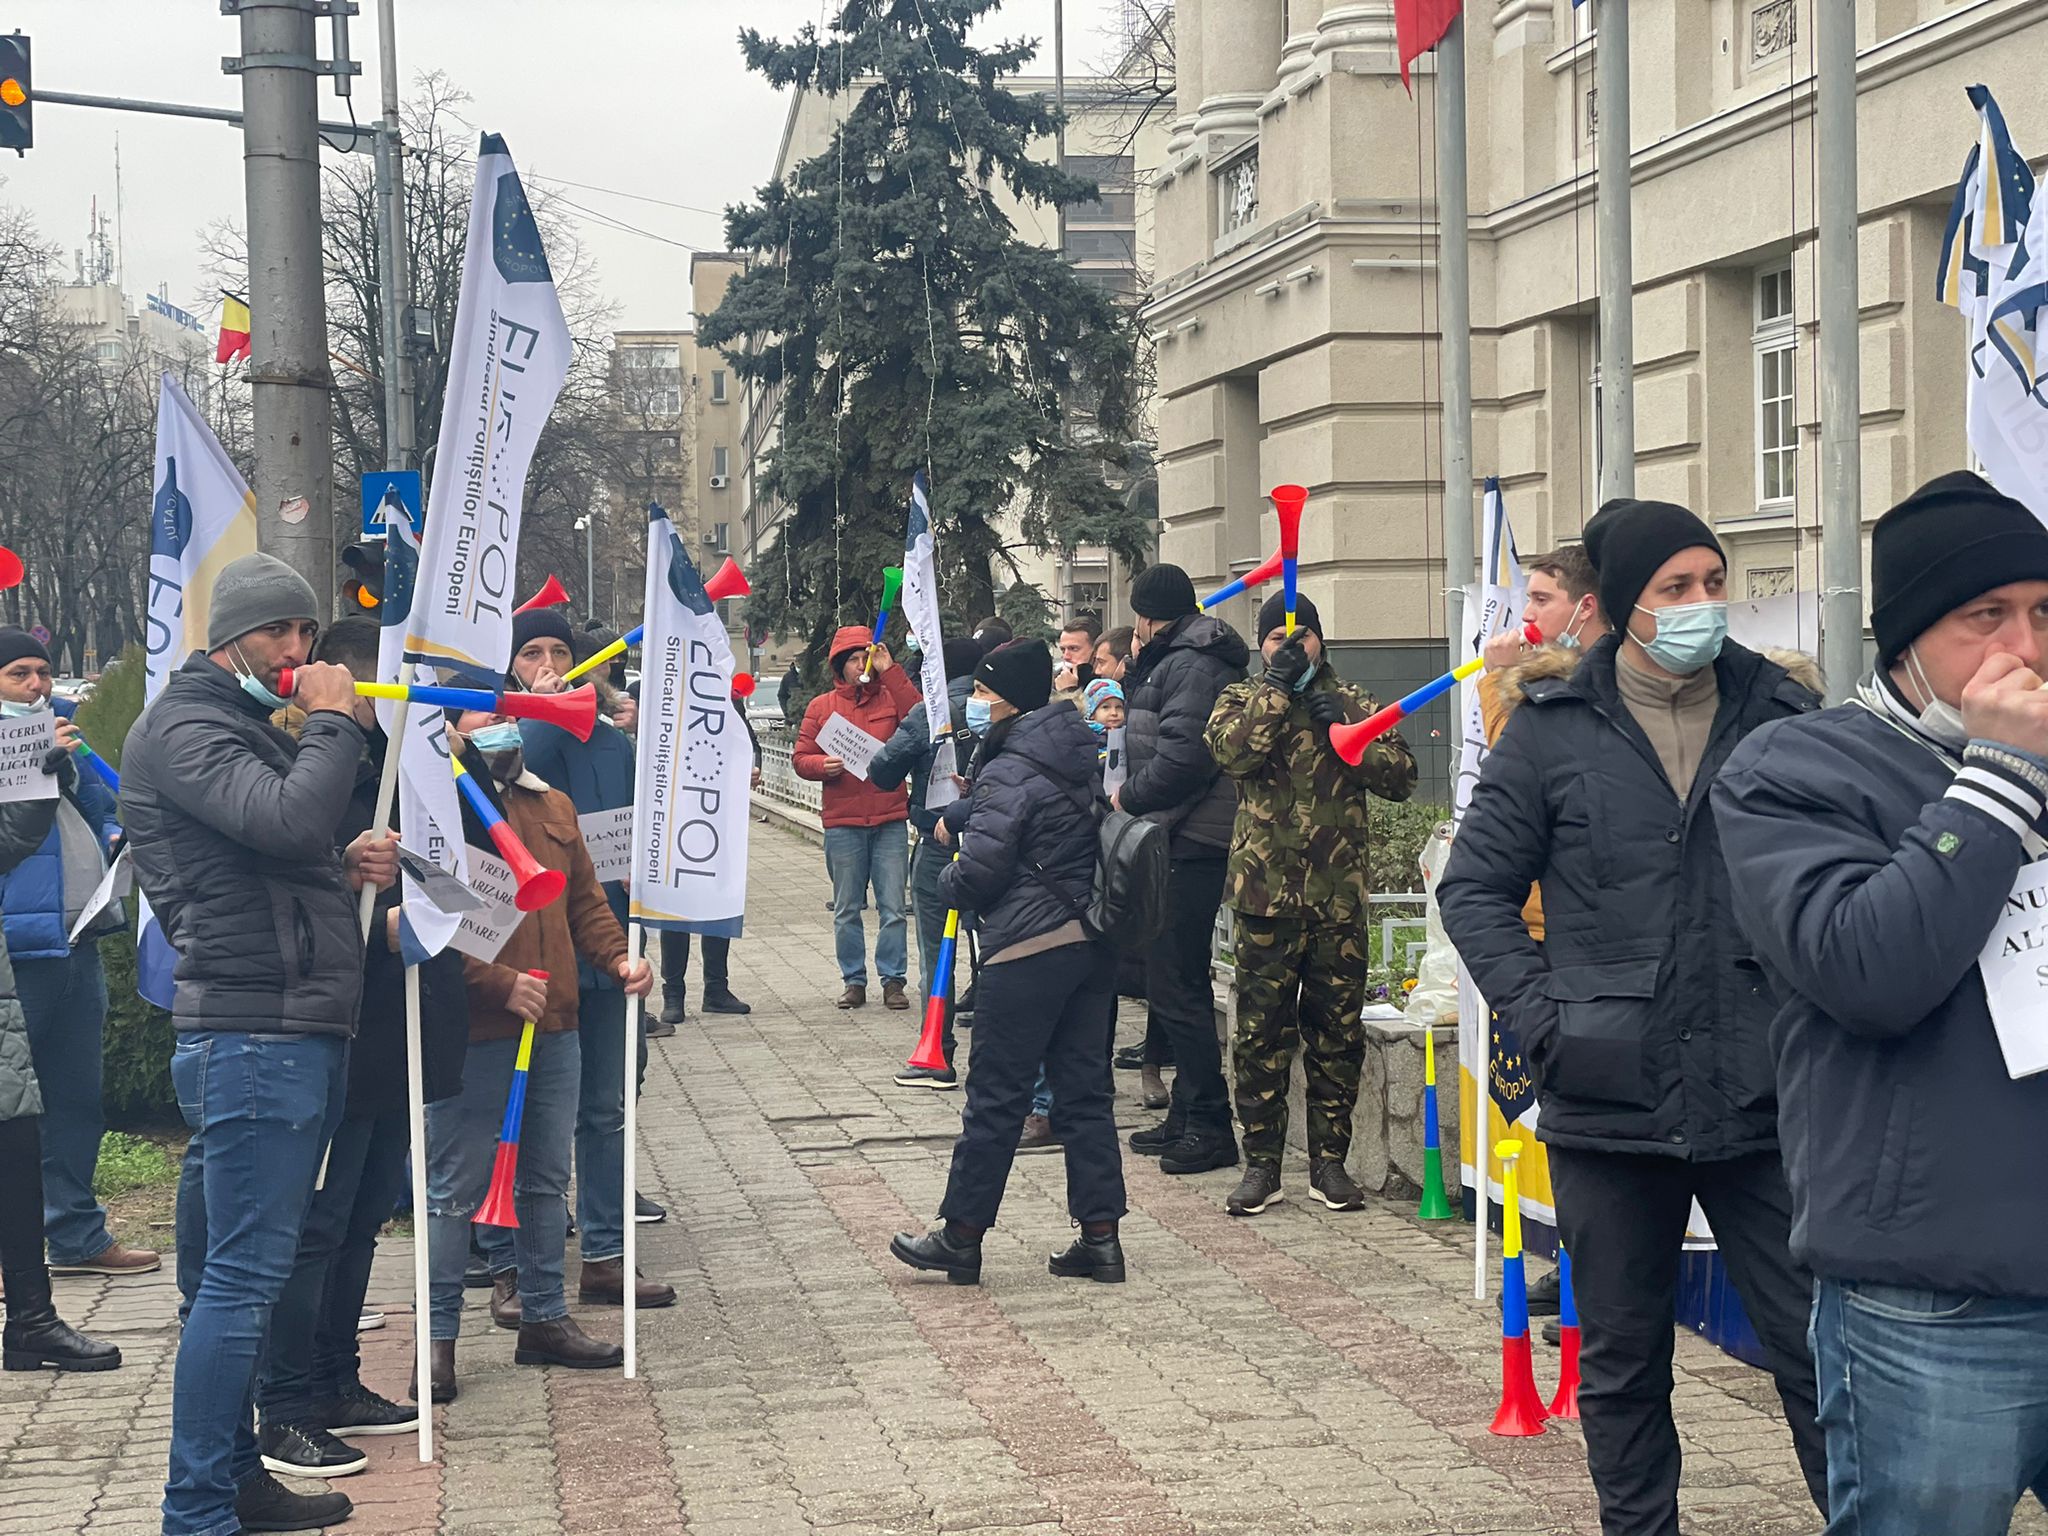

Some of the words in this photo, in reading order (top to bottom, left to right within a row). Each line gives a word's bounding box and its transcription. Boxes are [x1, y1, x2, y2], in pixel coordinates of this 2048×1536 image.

[445, 525, 476, 616] Europeni
[661, 635, 681, 717] Sindicatul
[9, 722, 46, 739] CEREM
[0, 745, 16, 755] VA
[20, 739, 49, 754] DOAR
[653, 722, 673, 807] Polițiștilor
[0, 777, 12, 788] EA
[614, 812, 634, 823] HO
[585, 827, 633, 843] LA-NCH
[647, 811, 665, 885] Europeni
[480, 860, 511, 882] VREM
[593, 855, 632, 869] GUVER
[468, 875, 515, 906] ARIZARE
[1489, 1058, 1532, 1101] EUROPOL
